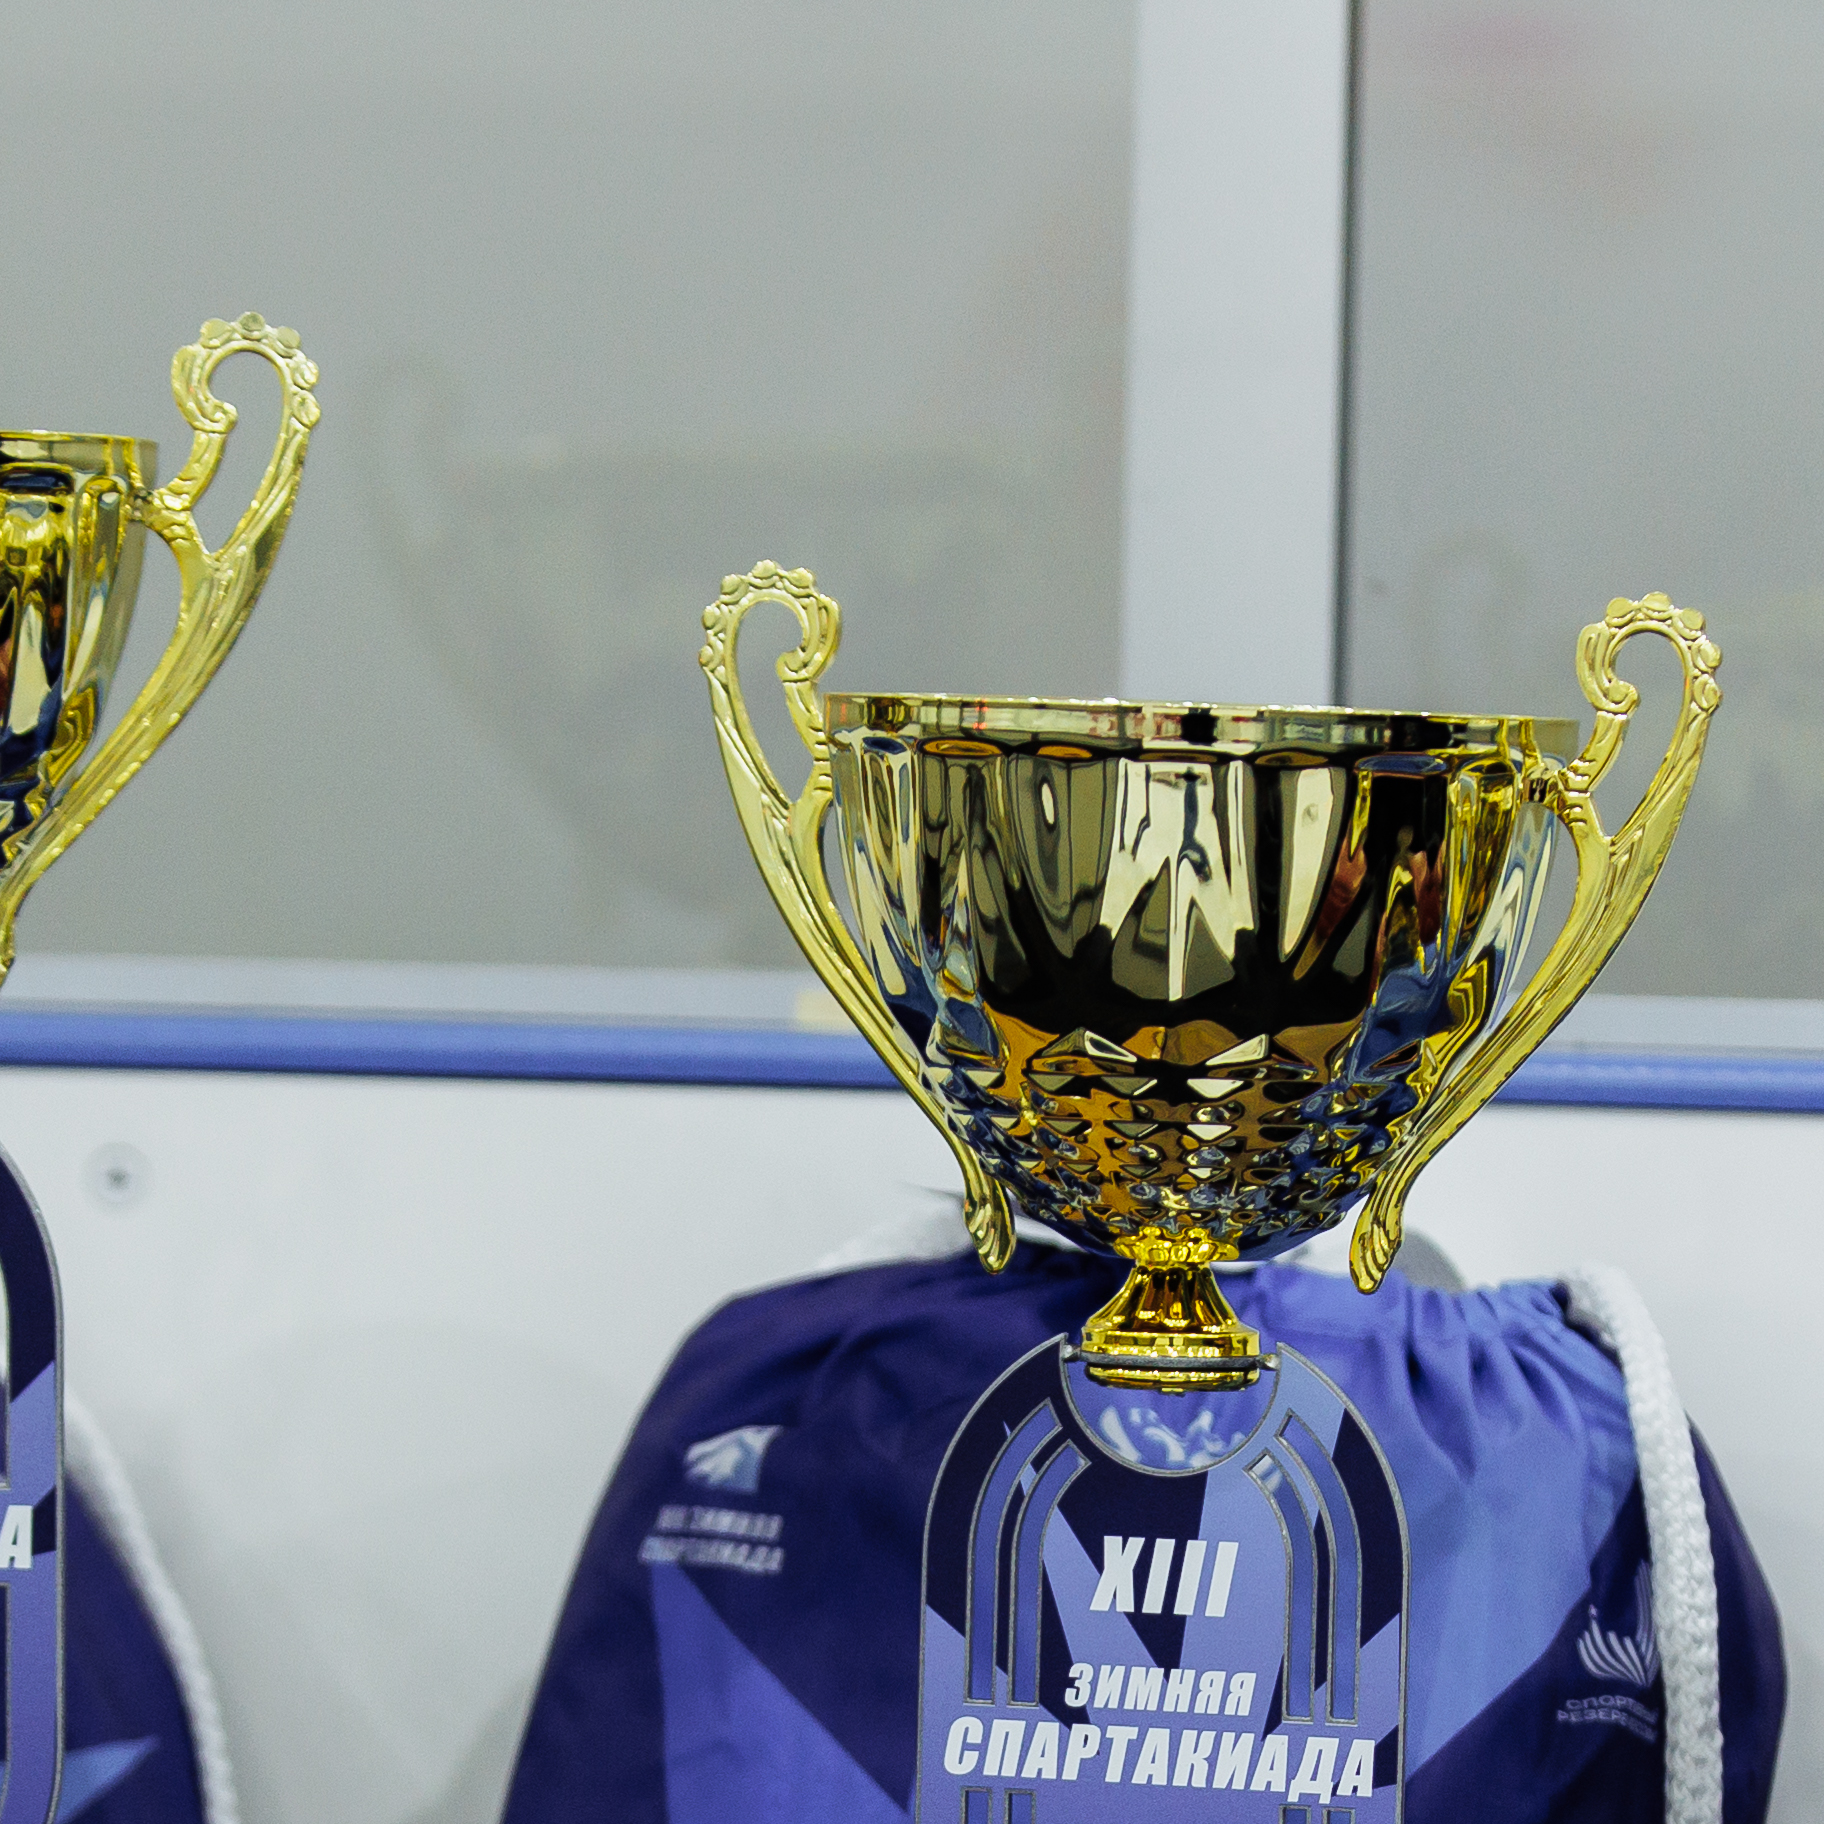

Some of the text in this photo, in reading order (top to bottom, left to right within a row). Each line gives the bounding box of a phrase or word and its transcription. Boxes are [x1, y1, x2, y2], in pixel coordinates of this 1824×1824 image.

[1089, 1536, 1239, 1617] XIII
[1064, 1663, 1257, 1717] ЗИМНЯЯ
[943, 1716, 1376, 1804] СПАРТАКИАДА
